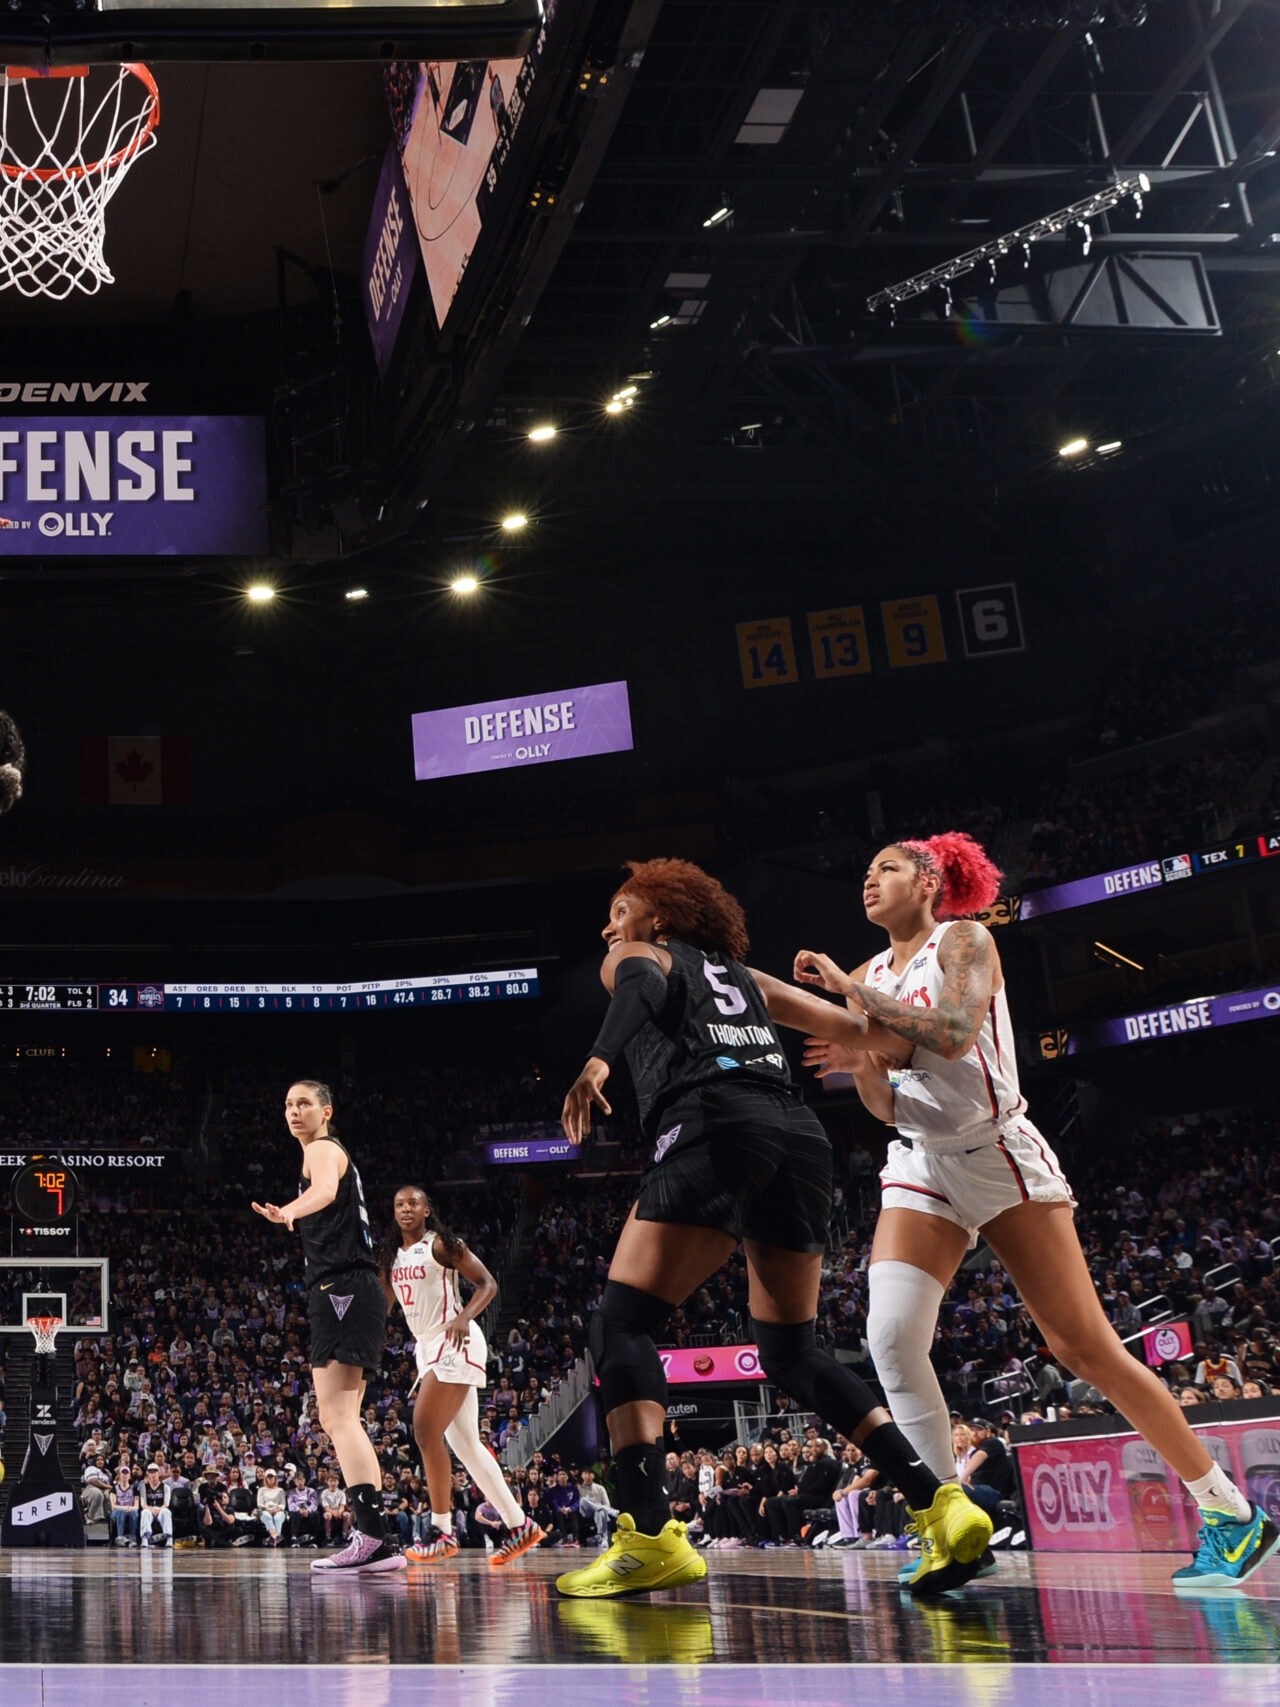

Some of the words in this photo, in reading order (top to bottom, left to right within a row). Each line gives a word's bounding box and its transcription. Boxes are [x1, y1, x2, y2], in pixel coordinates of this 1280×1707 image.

[368, 185, 404, 322] DEFENSE
[22, 521, 31, 529] BY
[38, 511, 114, 537] OLLY
[972, 599, 1008, 641] 6
[903, 623, 927, 656] 9
[748, 643, 787, 680] 14
[821, 633, 860, 670] 13
[465, 701, 575, 744] DEFENSE
[515, 743, 551, 760] OLLY
[1201, 851, 1228, 865] TEX
[1104, 864, 1162, 895] DEFENS
[8, 987, 14, 996] 3
[86, 987, 92, 996] 4
[361, 983, 381, 991] PITP
[395, 980, 413, 988] 2P%
[432, 977, 450, 985] 3P%
[470, 973, 488, 982] FG%
[508, 971, 526, 979] FT%
[703, 959, 748, 1015] 5
[8, 999, 14, 1008] 3
[25, 986, 56, 1001] 7:02
[86, 999, 93, 1008] 2
[109, 989, 128, 1006] 34
[176, 997, 182, 1008] 7
[204, 997, 211, 1008] 8
[229, 997, 240, 1008] 15
[258, 998, 265, 1008] 3
[286, 998, 292, 1008] 5
[313, 998, 320, 1008] 8
[340, 997, 347, 1008] 7
[366, 995, 377, 1006] 16
[393, 991, 415, 1003] 47.4
[431, 988, 452, 1001] 26.7
[468, 986, 490, 998] 38.2
[506, 983, 529, 995] 80.0
[1124, 1002, 1212, 1041] DEFENSE
[707, 1023, 775, 1047] THORNTON
[25, 1048, 56, 1057] CLUB
[108, 1155, 165, 1167] RESORT
[494, 1147, 529, 1159] DEFENSE
[549, 1145, 570, 1154] OLLY
[34, 1172, 65, 1188] 7:02
[47, 1188, 62, 1216] 7
[33, 1227, 71, 1236] TISSOT
[392, 1265, 426, 1283] ystics
[399, 1284, 415, 1306] 12
[1036, 1468, 1110, 1526] OLLY
[17, 1496, 67, 1522] IREN
